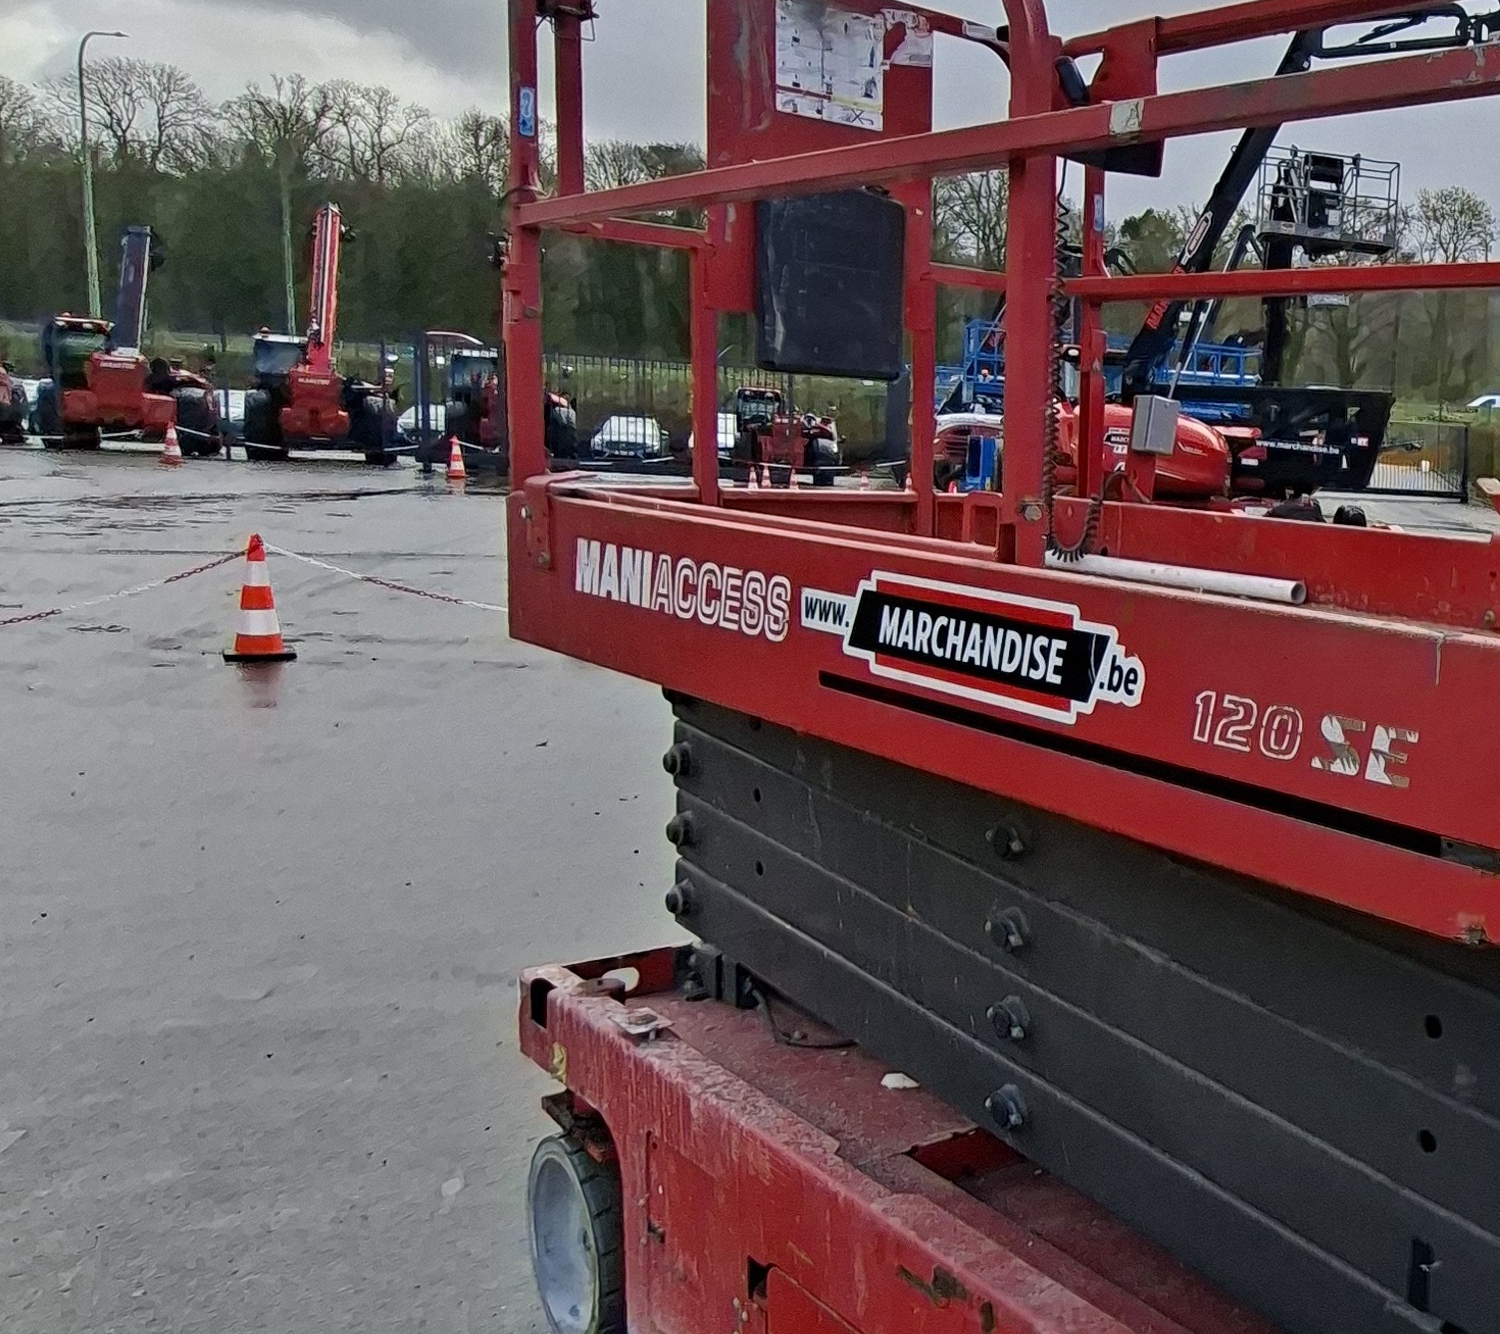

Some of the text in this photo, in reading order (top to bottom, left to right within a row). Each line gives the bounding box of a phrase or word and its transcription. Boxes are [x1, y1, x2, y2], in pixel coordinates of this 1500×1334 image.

[804, 595, 850, 628] www.
[878, 605, 1068, 685] MARCHANDISE
[1193, 690, 1420, 788] 120 SE
